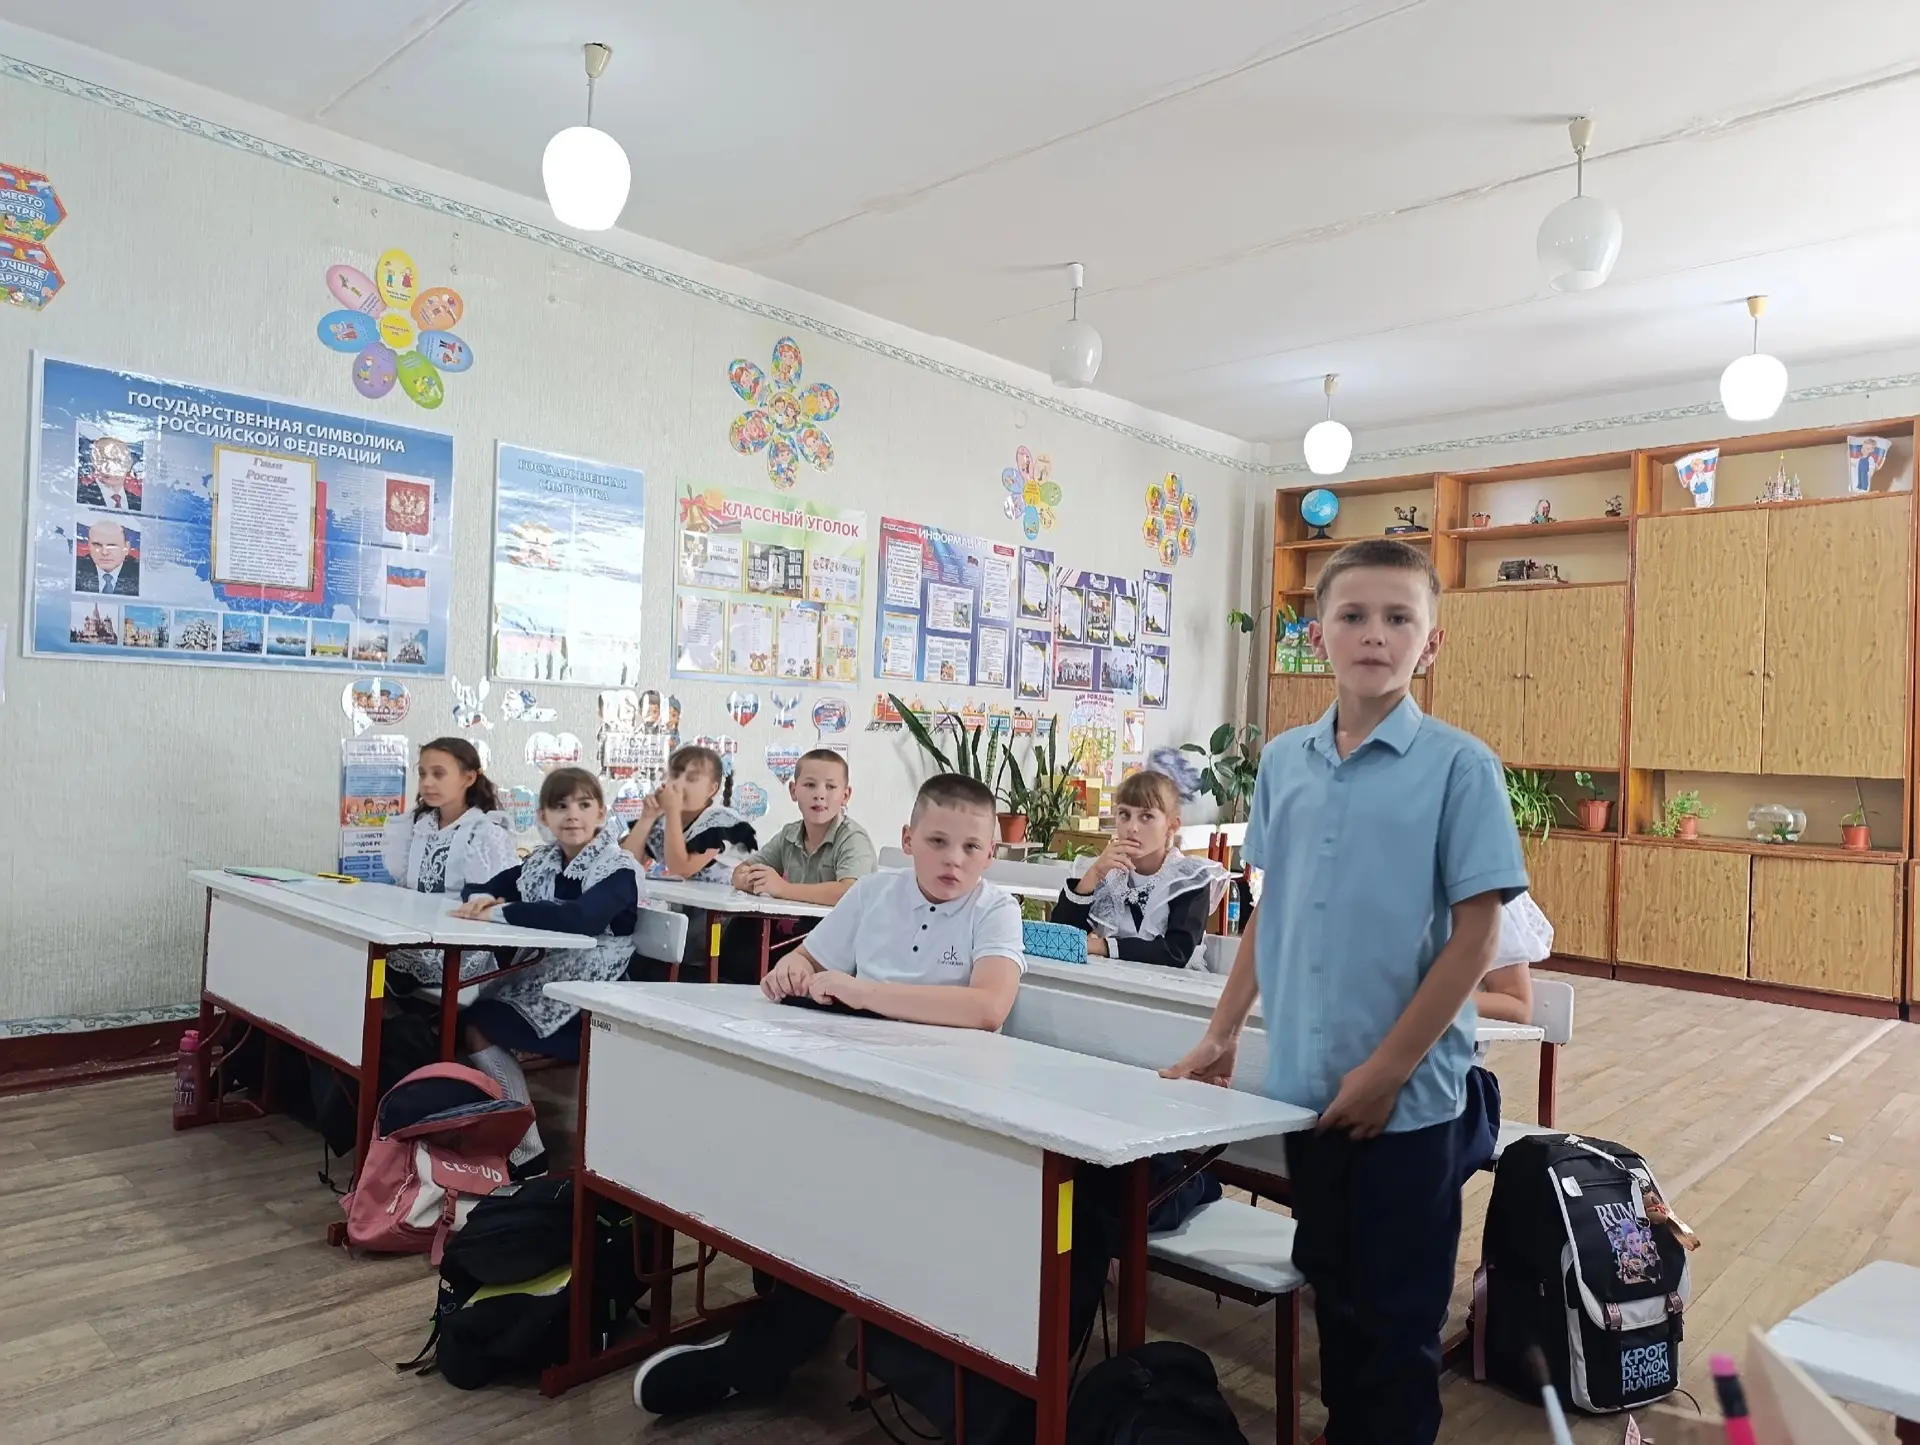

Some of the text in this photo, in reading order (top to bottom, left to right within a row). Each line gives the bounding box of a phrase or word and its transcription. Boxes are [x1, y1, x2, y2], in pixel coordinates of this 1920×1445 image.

[0, 190, 44, 208] МЕСТО
[0, 204, 44, 221] ВСТРЕЧ
[0, 260, 48, 279] УЧШИЕ
[128, 391, 406, 453] ГОСУДАРСТВЕННАЯ СИМВОЛИКА
[158, 415, 382, 465] РОССИЙСКОЙ ФЕДЕРАЦИИ
[253, 457, 283, 470] Гимн
[518, 459, 627, 489] ГОСУДАРСТВЕННАЯ
[245, 469, 288, 485] России
[721, 501, 804, 528] КЛАССНЫЙ
[807, 516, 860, 538] УГОЛОК
[943, 945, 958, 961] ck
[174, 1091, 196, 1106] OTTL
[1594, 1201, 1636, 1233] RUM
[1621, 1341, 1668, 1366] K-POP
[1621, 1357, 1669, 1380] DEMON
[1622, 1370, 1671, 1396] HUNTERS
